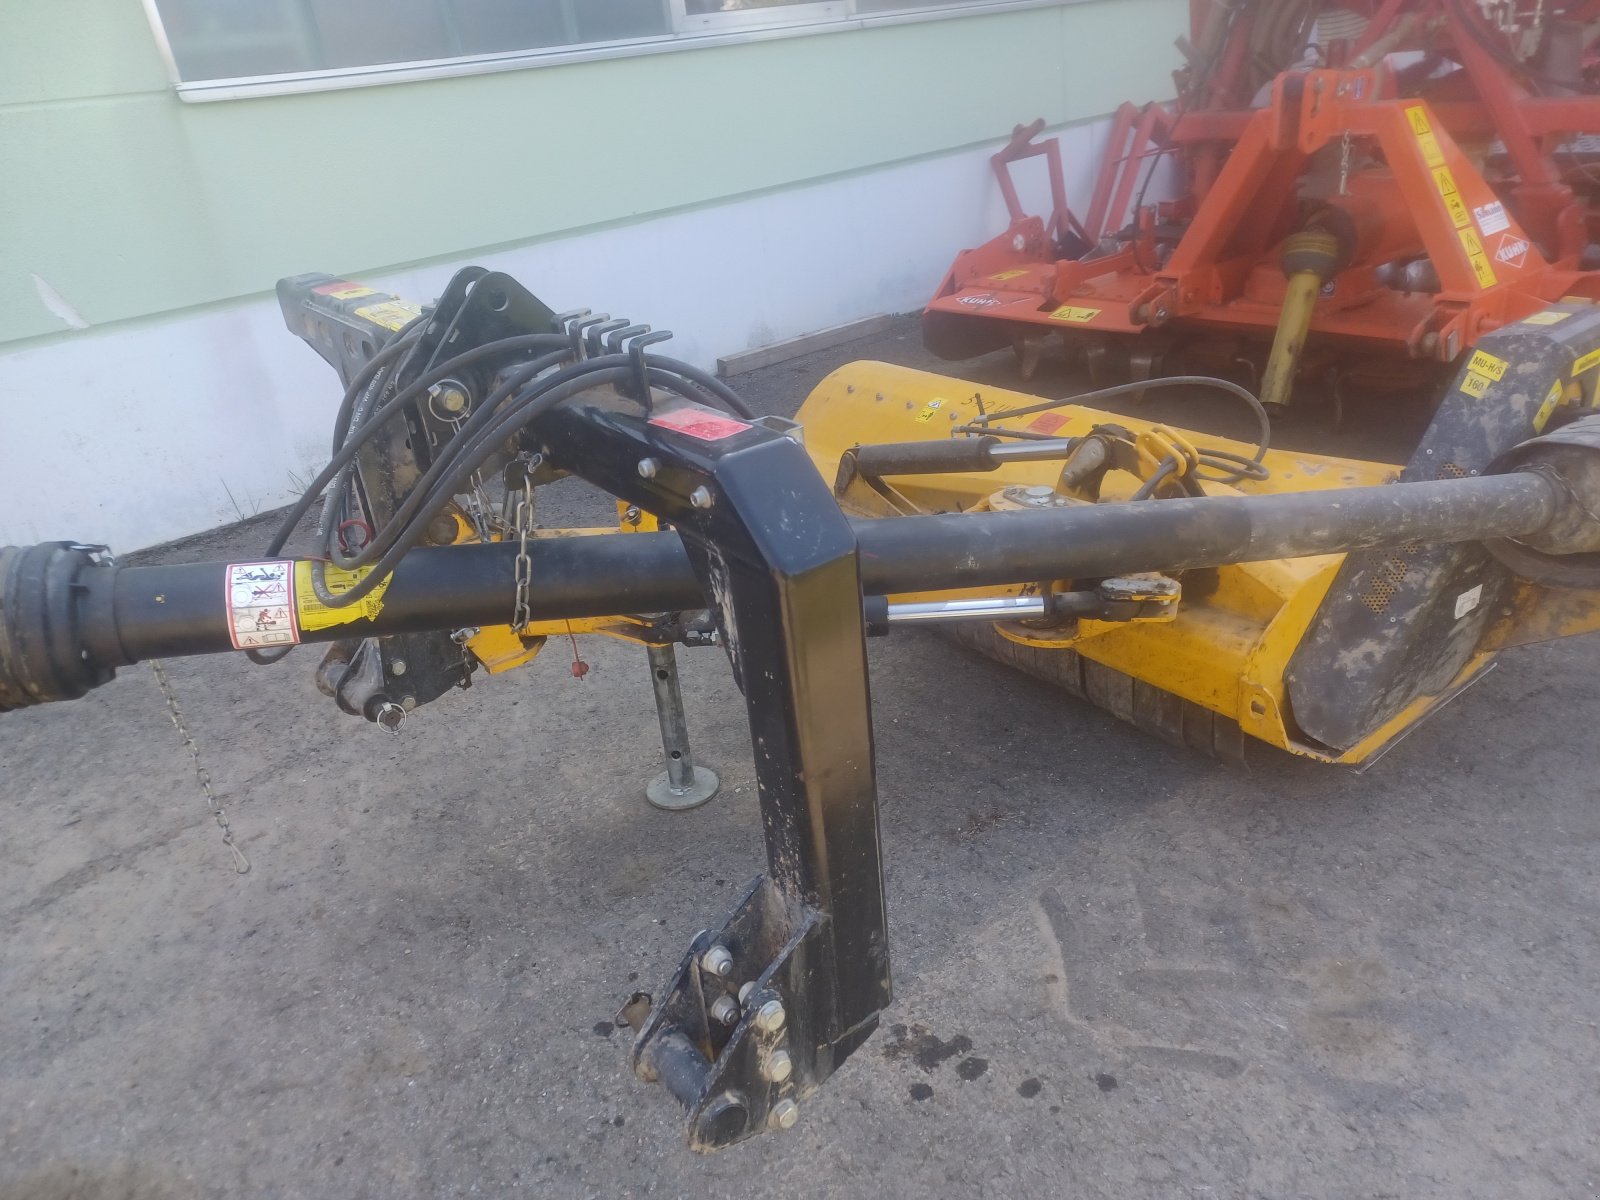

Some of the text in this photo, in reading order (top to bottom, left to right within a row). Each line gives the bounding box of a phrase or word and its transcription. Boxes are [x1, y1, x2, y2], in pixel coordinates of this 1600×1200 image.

[1499, 241, 1528, 261] KUHN
[961, 296, 994, 306] KUHN
[374, 366, 386, 380] BAR
[1473, 356, 1503, 376] MU-H/S
[1467, 378, 1484, 392] 160
